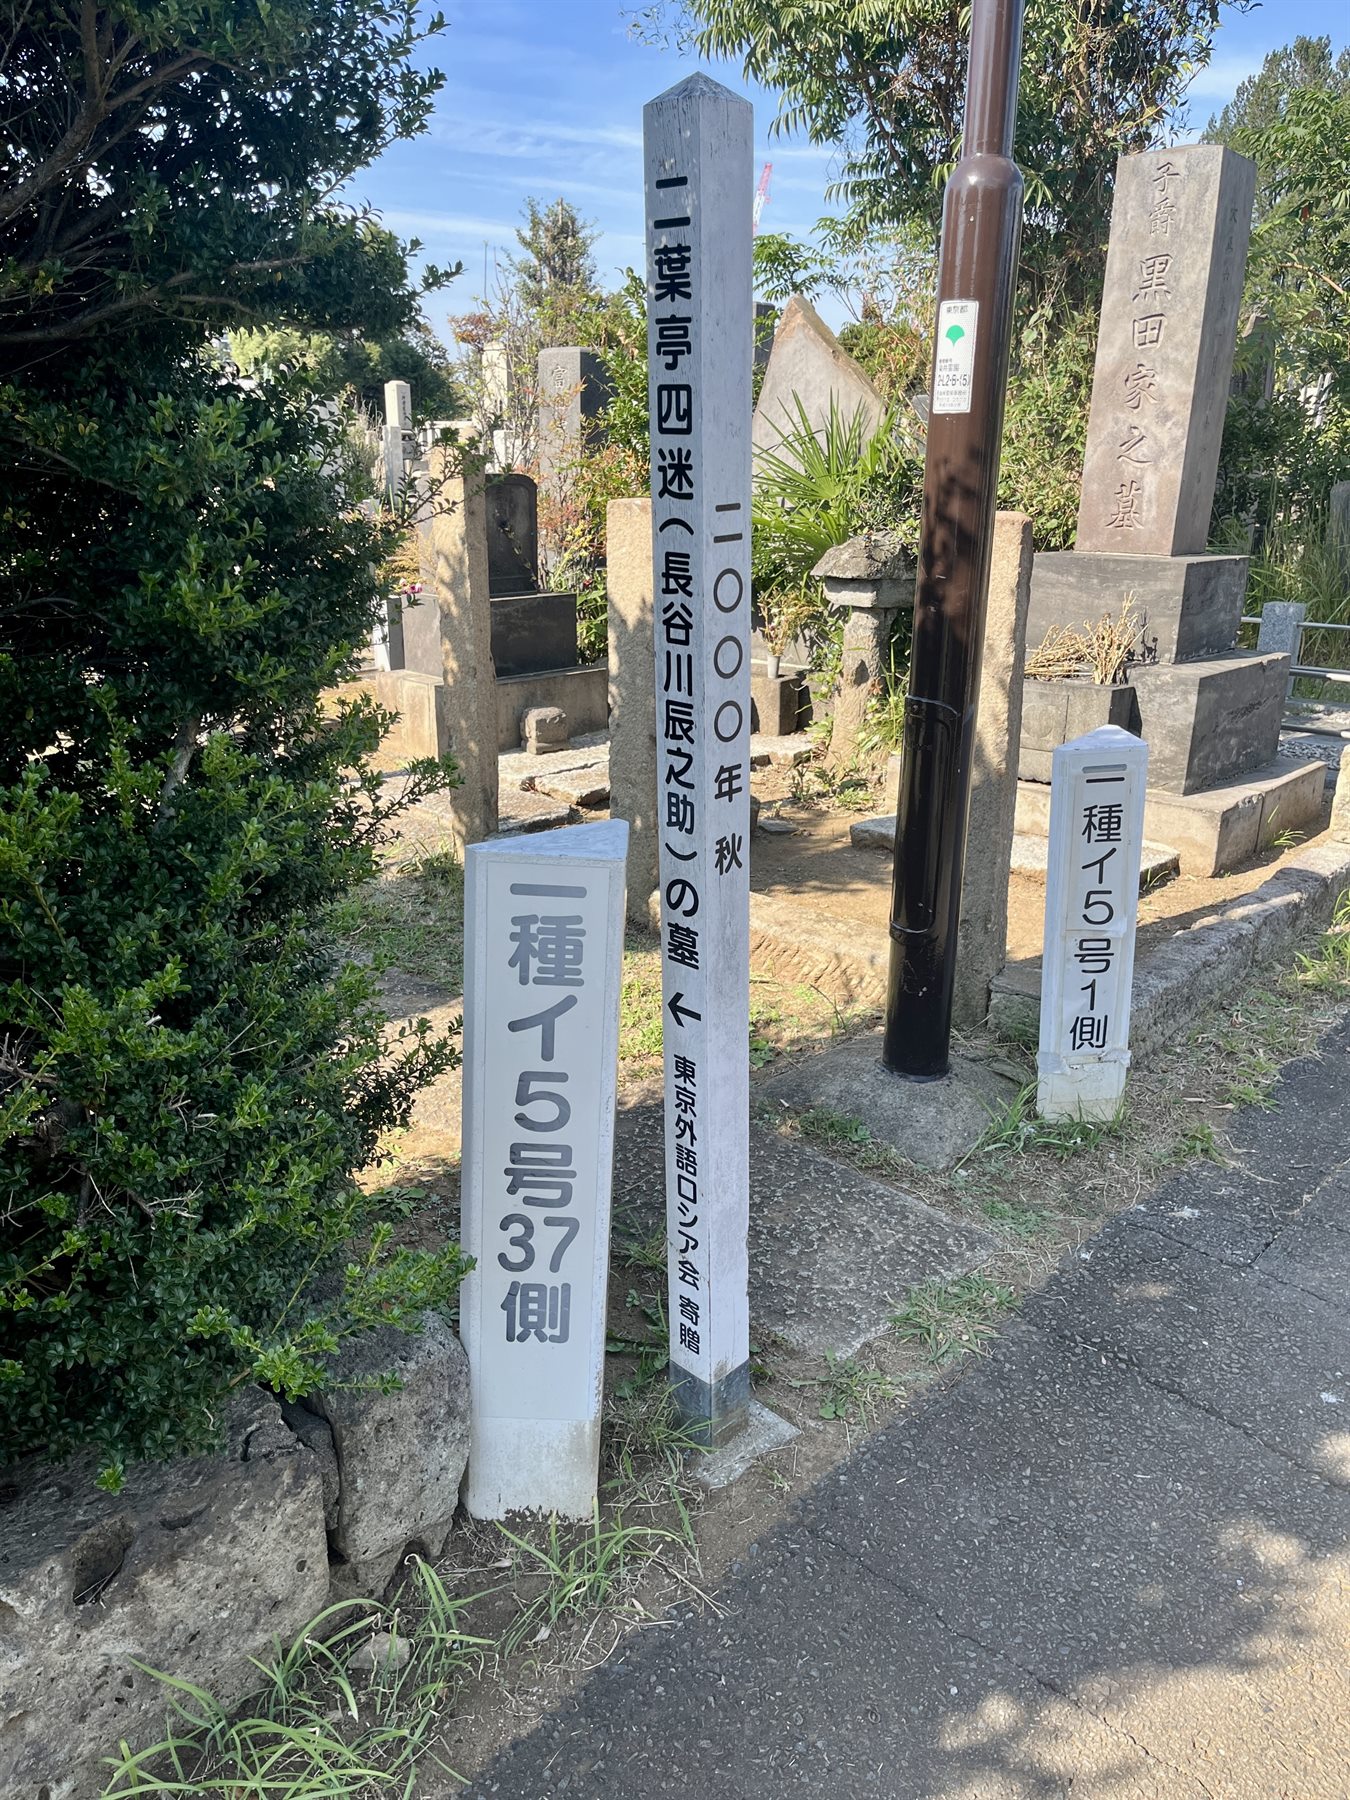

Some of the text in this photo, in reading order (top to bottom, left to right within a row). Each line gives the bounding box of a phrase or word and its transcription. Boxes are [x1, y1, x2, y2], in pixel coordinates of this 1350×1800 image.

[497, 882, 588, 1344] 一種イ5号37側
